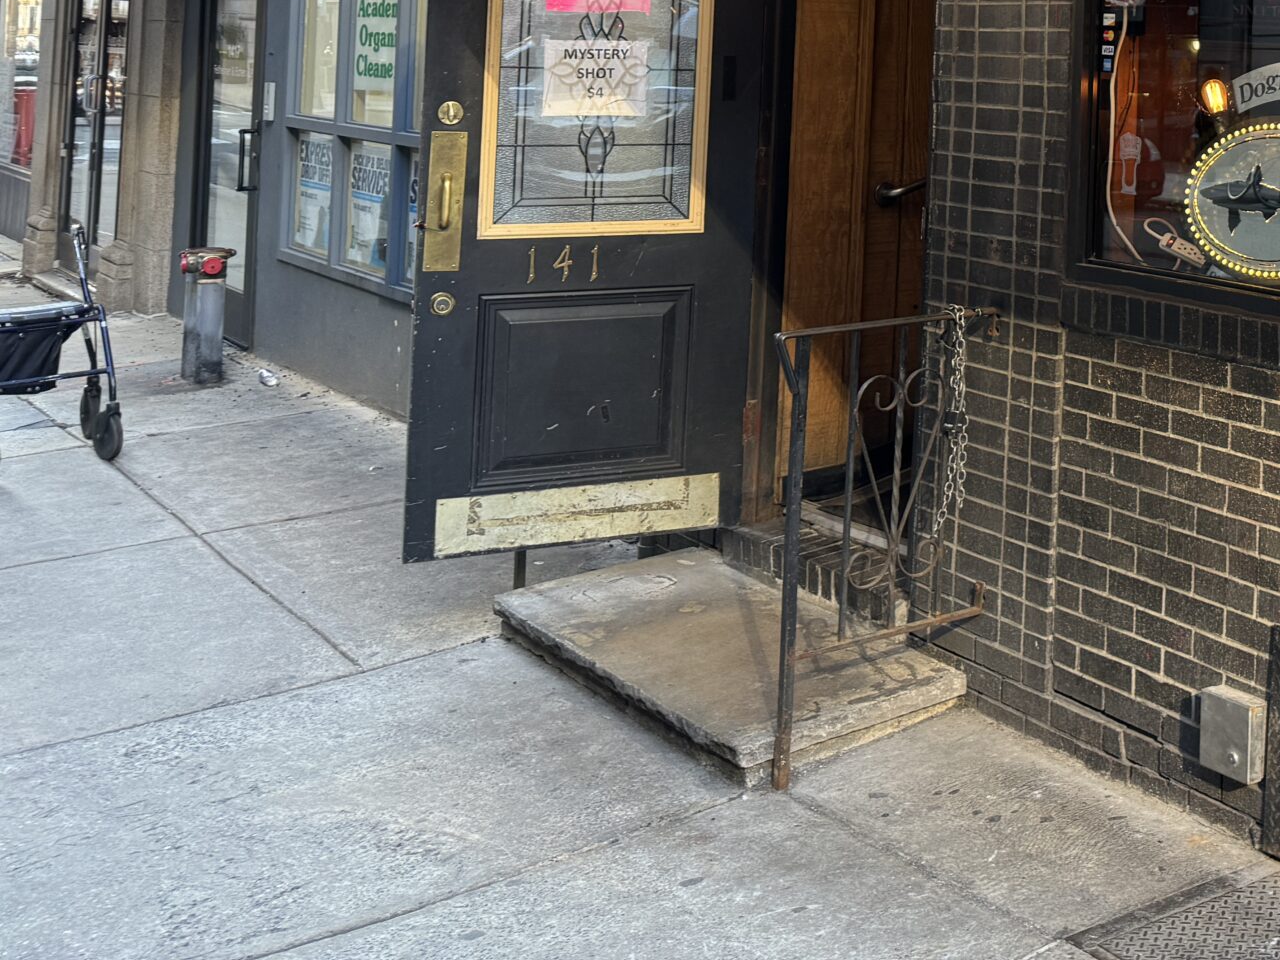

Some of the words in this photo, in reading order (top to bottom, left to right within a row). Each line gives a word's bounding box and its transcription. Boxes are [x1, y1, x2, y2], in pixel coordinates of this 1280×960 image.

[563, 47, 630, 60] MYSTERY
[576, 67, 615, 80] SHOT
[587, 86, 604, 100] $4
